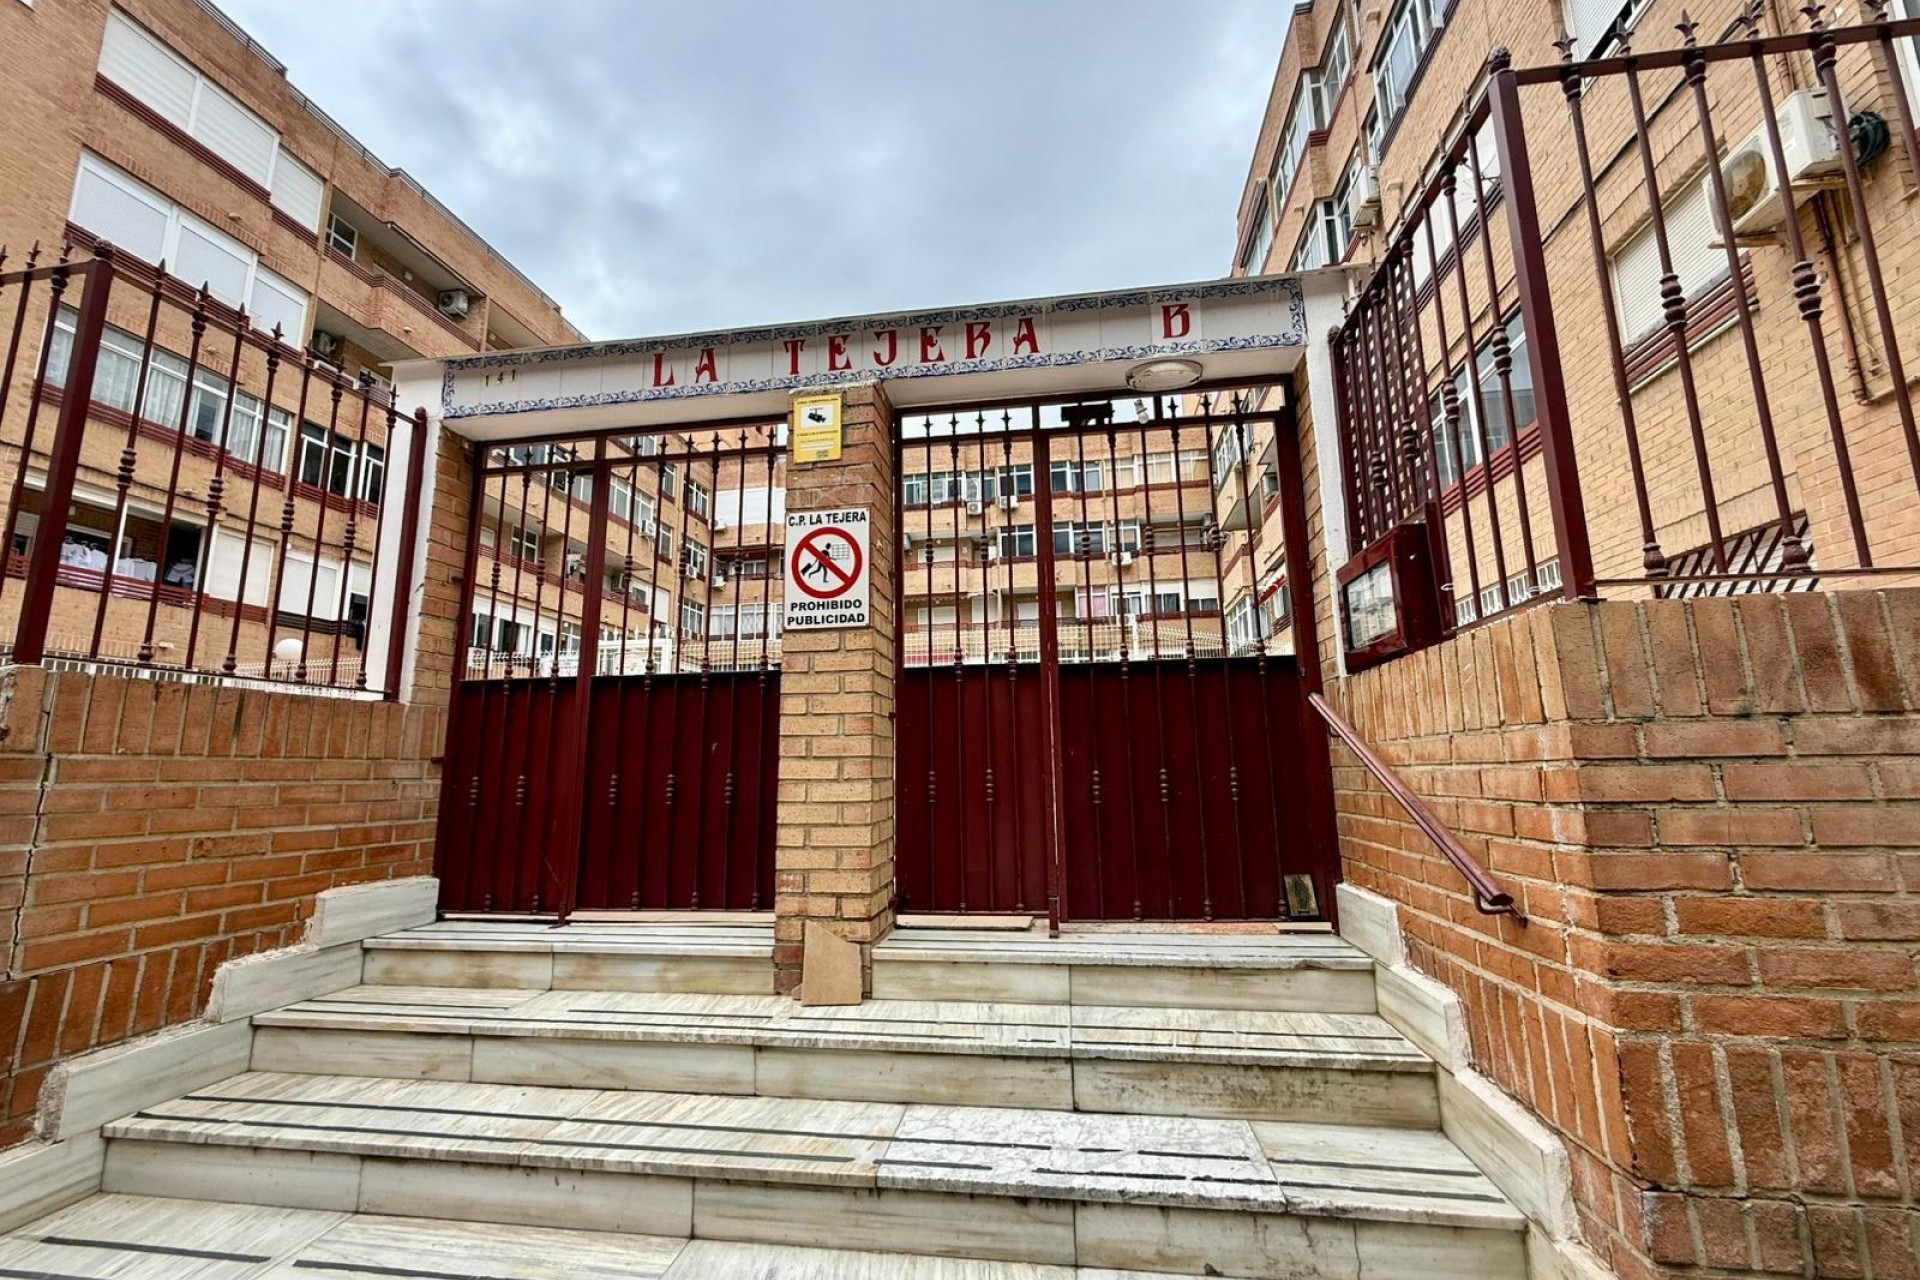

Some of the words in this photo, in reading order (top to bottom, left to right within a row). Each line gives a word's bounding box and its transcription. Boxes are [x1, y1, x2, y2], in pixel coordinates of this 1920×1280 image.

[653, 347, 718, 387] LA
[783, 317, 1040, 376] TEJERA
[788, 515, 806, 526] C.P.
[809, 514, 822, 525] LA
[825, 511, 866, 524] TEJERA
[790, 599, 862, 611] PROHIBIDO
[787, 613, 865, 626] PUBLICIDAD
